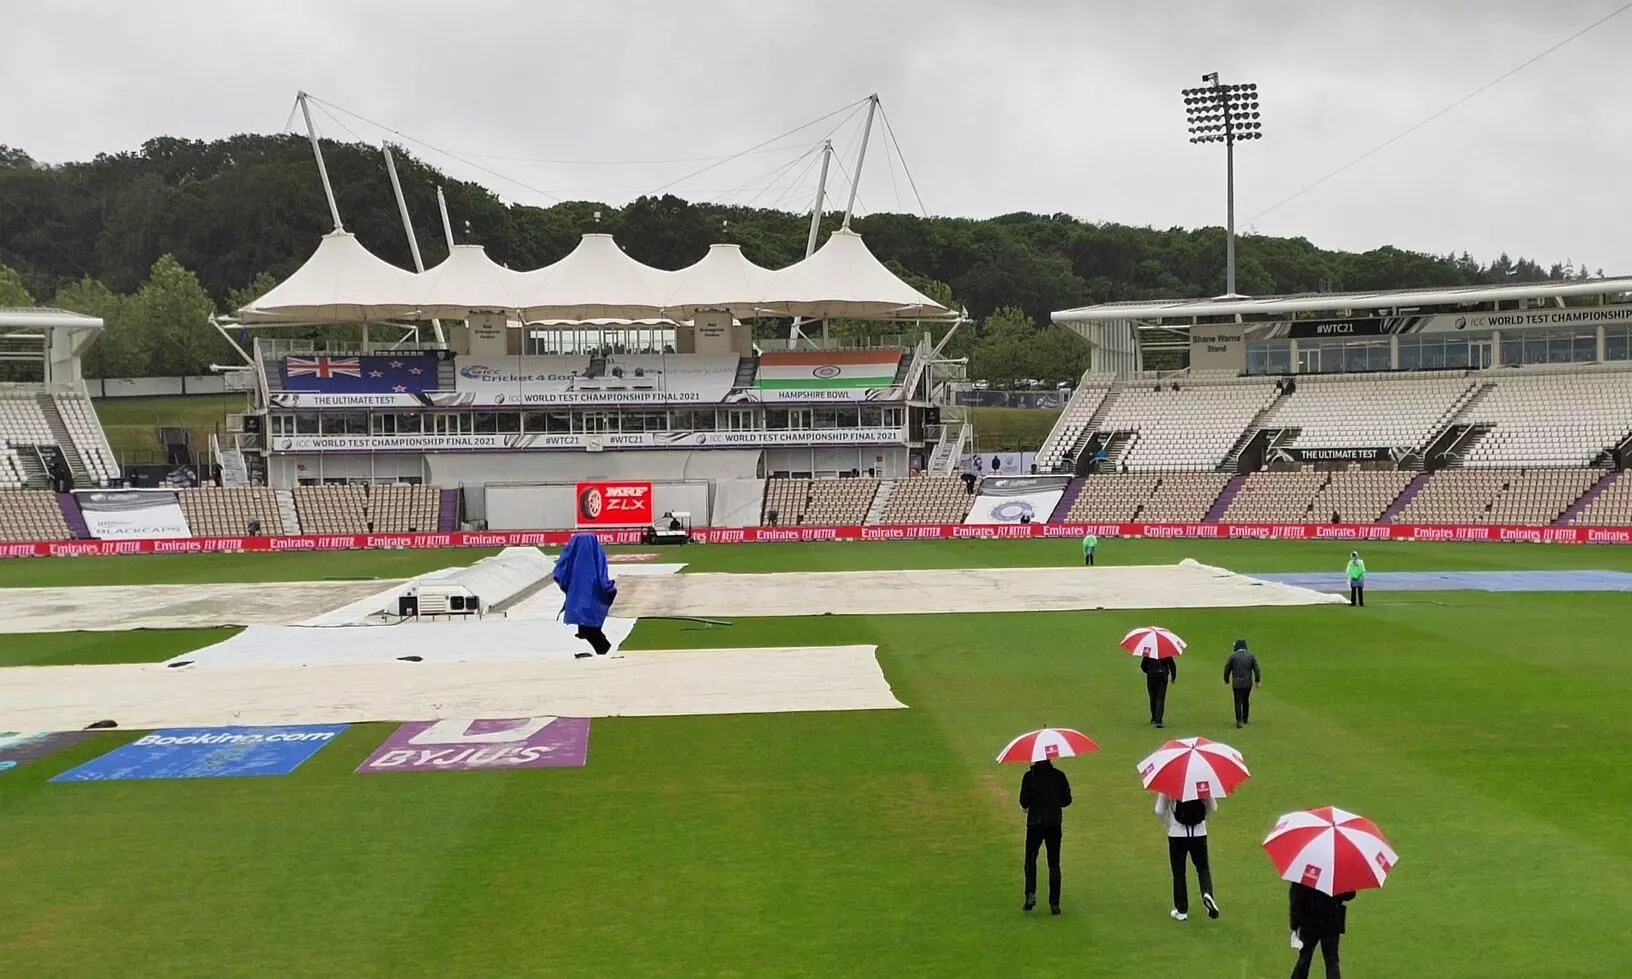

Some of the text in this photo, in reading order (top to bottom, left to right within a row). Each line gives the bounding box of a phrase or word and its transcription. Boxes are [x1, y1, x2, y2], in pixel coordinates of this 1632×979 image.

[1488, 316, 1524, 326] WORLD
[1525, 314, 1550, 324] TEST
[1551, 309, 1632, 323] CHAMPIONSHIP
[1316, 323, 1354, 334] #WTC21
[1192, 334, 1241, 343] Shane Warne
[1207, 344, 1227, 353] Stand
[482, 374, 534, 382] Cricket
[314, 396, 395, 405] THE ULTIMATE TEST
[508, 394, 522, 402] ICC
[524, 394, 556, 402] WORLD
[581, 393, 650, 401] CHAMPIONSHIP
[652, 393, 678, 401] FINAL
[679, 392, 699, 400] 2021
[778, 391, 851, 399] HAMPSHIRE BOWL
[296, 437, 495, 448] ICC WORLD TEST CHAMPIONSHIP FINAL 2021
[546, 437, 579, 445] #WTC21
[610, 436, 643, 444] #WTC21
[709, 435, 723, 443] ICC
[758, 434, 777, 442] TEST
[779, 434, 848, 442] CHAMPIONSHIP
[850, 433, 876, 441] FINAL
[877, 432, 897, 440] 2021
[1301, 450, 1377, 459] THE ULTIMATE TEST
[605, 486, 648, 497] MRF
[606, 499, 645, 511] ZLX
[709, 530, 721, 541] FLY
[721, 530, 744, 540] BETTER
[757, 528, 836, 539] Emirates FLY BETTER
[862, 527, 941, 538] Emirates FLY BETTER
[953, 526, 1031, 537] Emirates FLY BETTER
[1043, 526, 1084, 535] Emirates
[1098, 525, 1120, 535] BETTER
[1144, 525, 1218, 536] Emirates FLY BETTER
[1229, 526, 1305, 537] Emirates FLY BETTER
[1316, 526, 1391, 537] Emirates FLY BETTER
[1414, 527, 1489, 539] Emirates FLY BETTER
[1500, 528, 1577, 540] Emirates FLY BETTER
[1588, 529, 1630, 541] Emirates
[270, 537, 355, 548] Emirates FLY BETTER
[367, 535, 450, 547] Emirates FLY BETTER
[463, 533, 544, 545] Emirates FLY BETTER
[616, 532, 628, 543] FLY
[9, 544, 35, 556] BETTER
[50, 541, 140, 555] Emirates FLY BETTER
[154, 539, 242, 551] Emirates FLY BETTER
[133, 732, 335, 746] Booking.com
